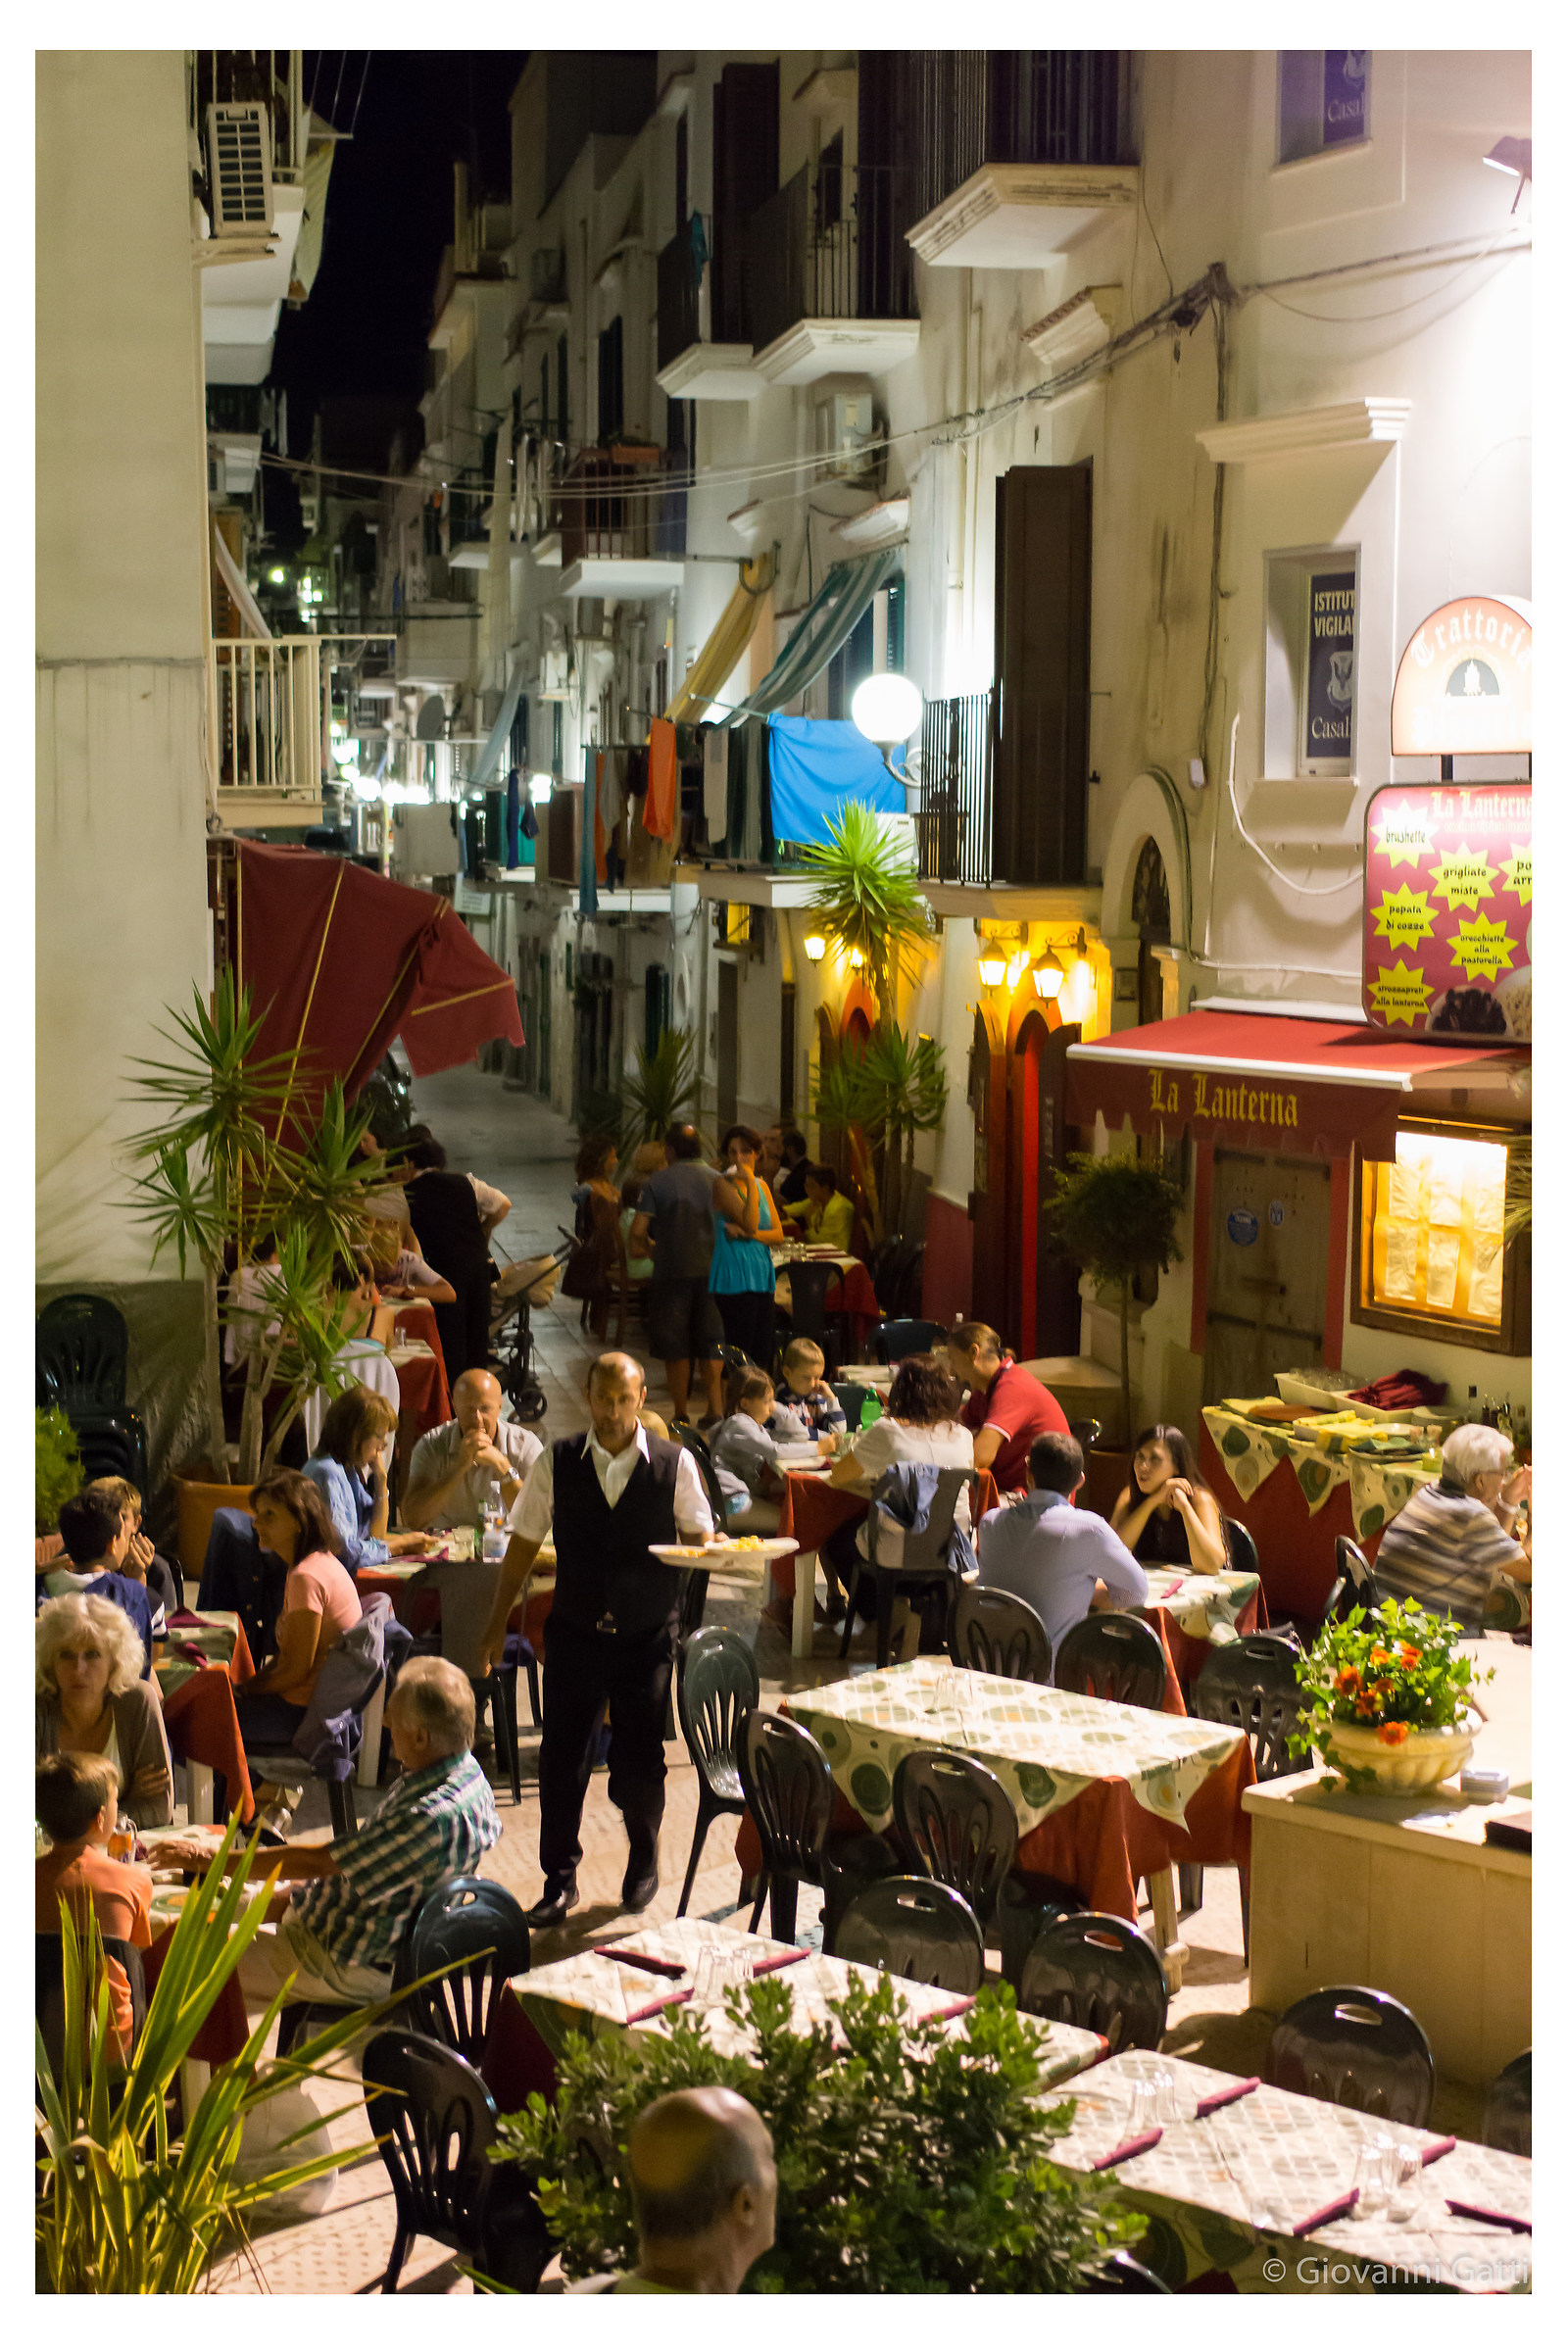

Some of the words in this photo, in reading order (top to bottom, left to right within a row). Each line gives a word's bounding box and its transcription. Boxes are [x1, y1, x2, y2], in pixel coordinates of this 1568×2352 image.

[1314, 614, 1354, 638] VIGILA
[1431, 791, 1454, 817] La
[1443, 864, 1488, 880] grigliate
[1450, 884, 1479, 896] miste
[1389, 906, 1422, 915] pepata
[1460, 933, 1505, 944] orecchiette
[1461, 956, 1503, 966] pastorella
[1392, 999, 1425, 1008] lanterna
[1149, 1068, 1179, 1113] La
[1192, 1072, 1298, 1127] Lanterna
